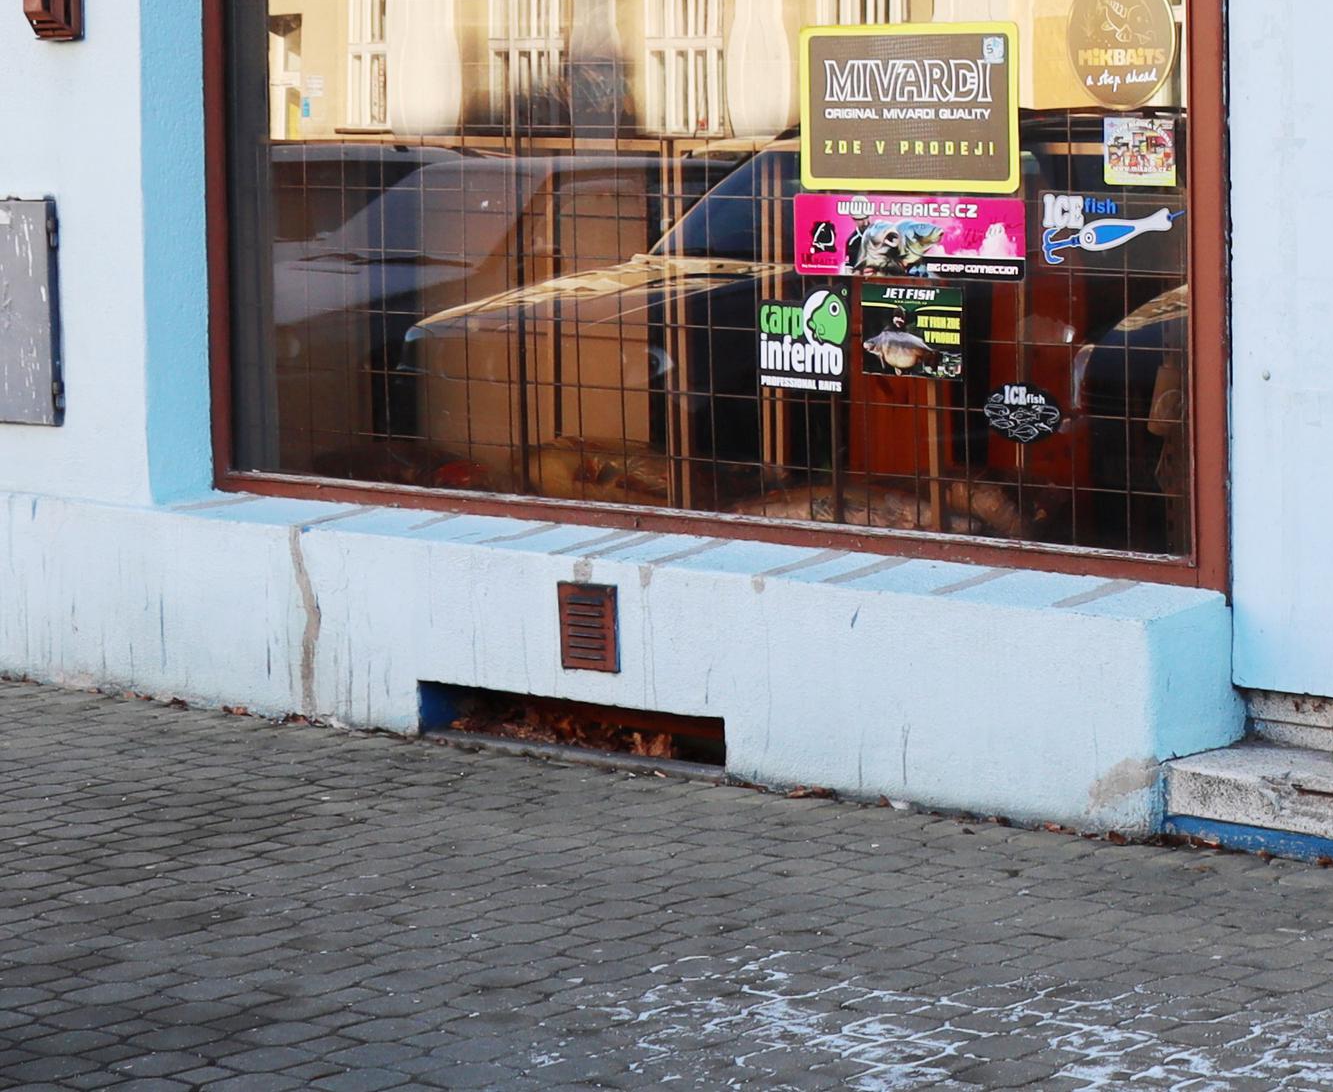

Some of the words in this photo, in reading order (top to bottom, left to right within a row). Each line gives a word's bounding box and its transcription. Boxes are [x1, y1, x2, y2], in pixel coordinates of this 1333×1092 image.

[824, 59, 993, 102] MIVARDI
[1086, 75, 1093, 86] a
[1097, 69, 1121, 92] step
[1126, 68, 1157, 85] ahead
[825, 108, 879, 120] ORIGINAL
[883, 108, 935, 120] MIVARDI
[939, 108, 991, 120] QUALITY
[824, 140, 862, 154] ZDE
[876, 140, 885, 154] V
[900, 140, 994, 156] PRODEJI
[926, 263, 941, 272] BIG
[941, 263, 965, 273] CARP
[965, 264, 1019, 275] CONNECTION
[882, 288, 906, 299] JET
[906, 289, 936, 300] FISH
[760, 304, 804, 339] carp
[924, 330, 931, 343] V
[760, 332, 843, 375] inferno
[760, 375, 817, 390] PROFESSIONAL
[818, 379, 842, 392] BAITS
